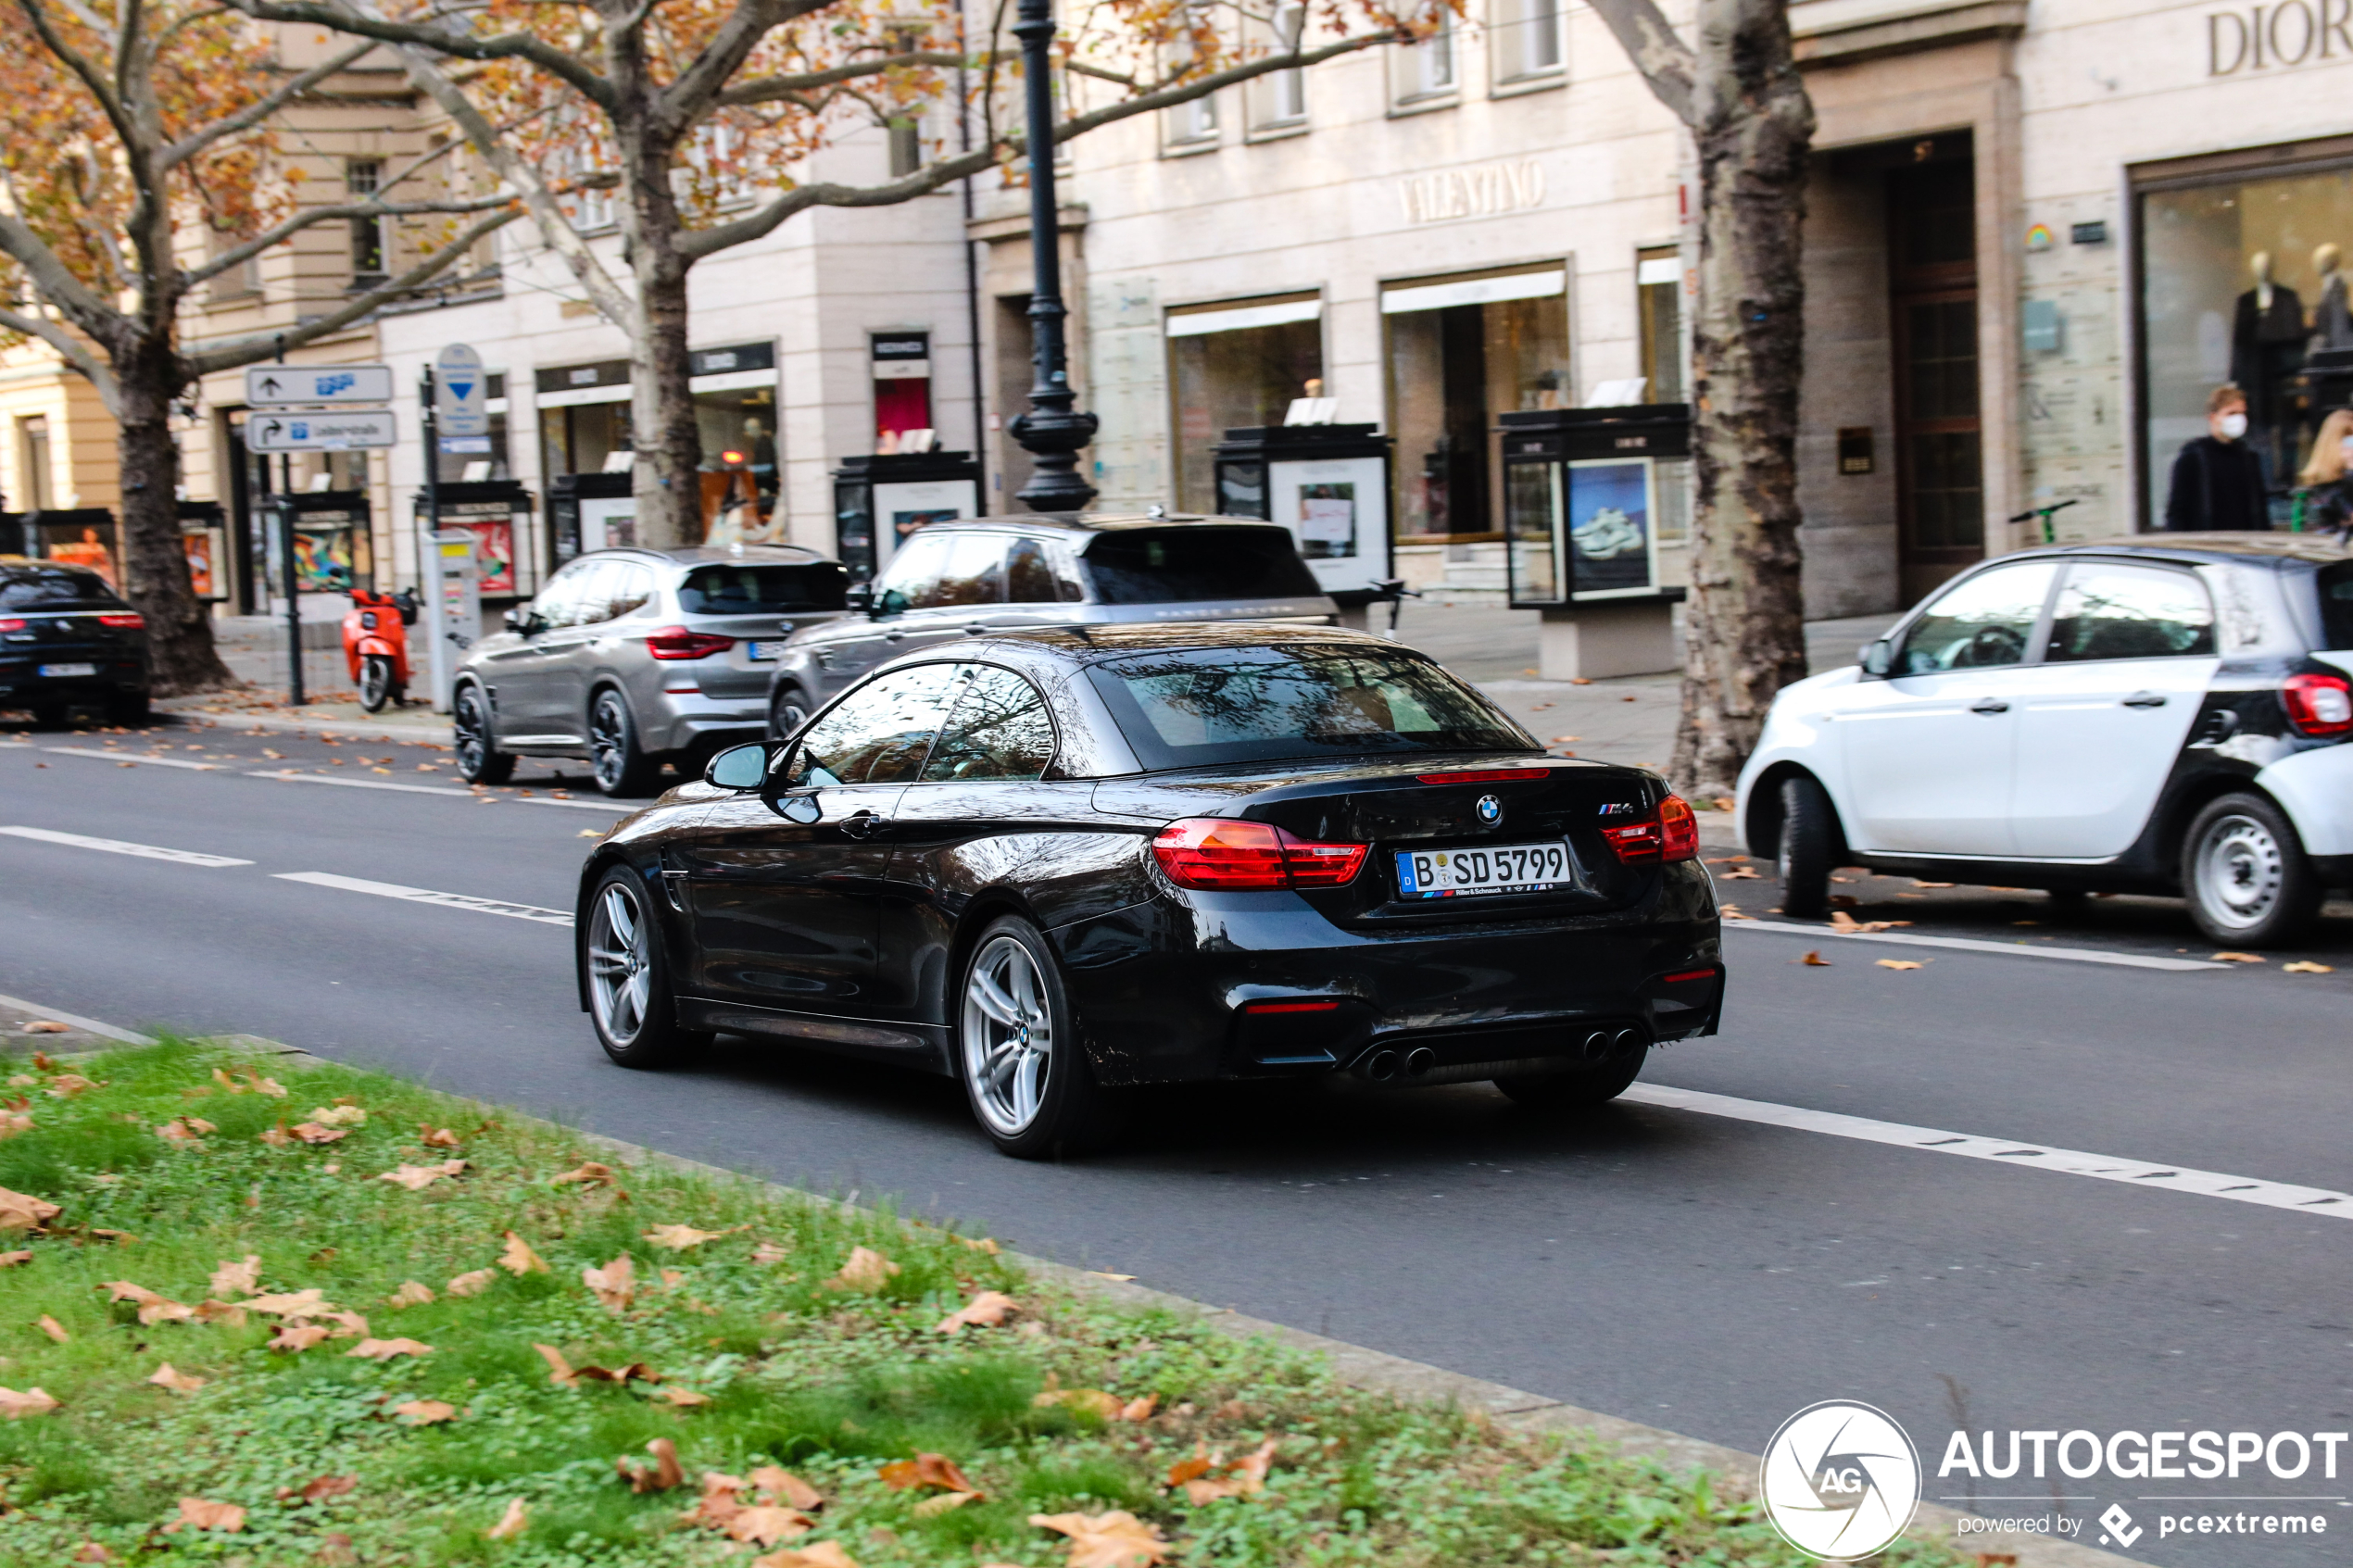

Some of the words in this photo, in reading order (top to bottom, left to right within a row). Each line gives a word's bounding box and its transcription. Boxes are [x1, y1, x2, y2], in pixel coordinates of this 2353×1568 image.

[2208, 0, 2353, 77] DIOR
[1404, 876, 1412, 886] D
[1415, 856, 1434, 886] B
[1453, 852, 1490, 884] SD
[1494, 847, 1563, 881] 5799
